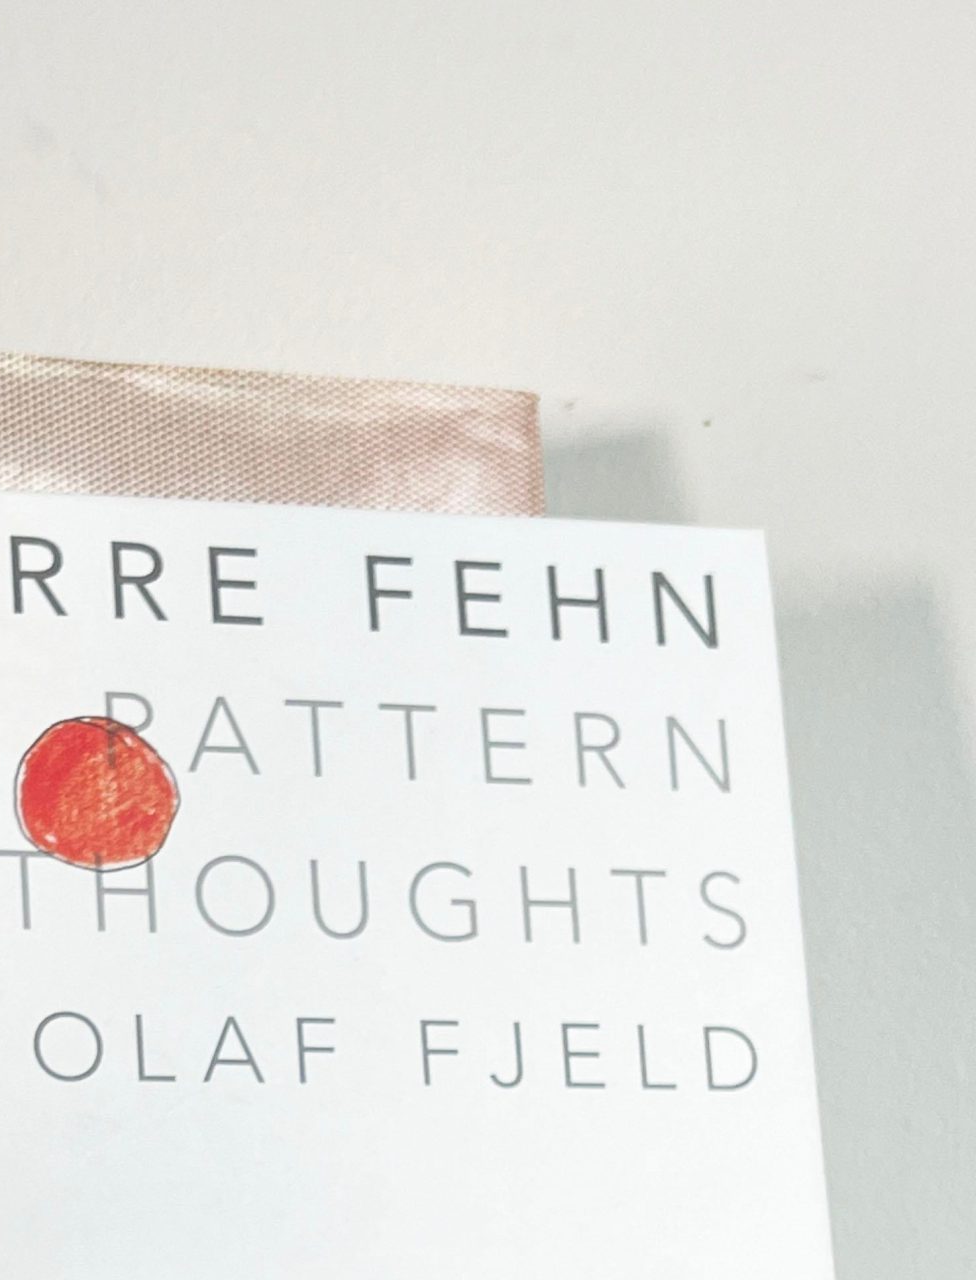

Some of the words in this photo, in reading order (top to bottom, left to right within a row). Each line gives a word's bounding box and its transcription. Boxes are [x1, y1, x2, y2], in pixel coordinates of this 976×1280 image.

[365, 554, 718, 649] FEHN
[104, 690, 731, 794] PATTERN
[33, 1010, 336, 1085] OLAF
[419, 1019, 758, 1091] FJELD
